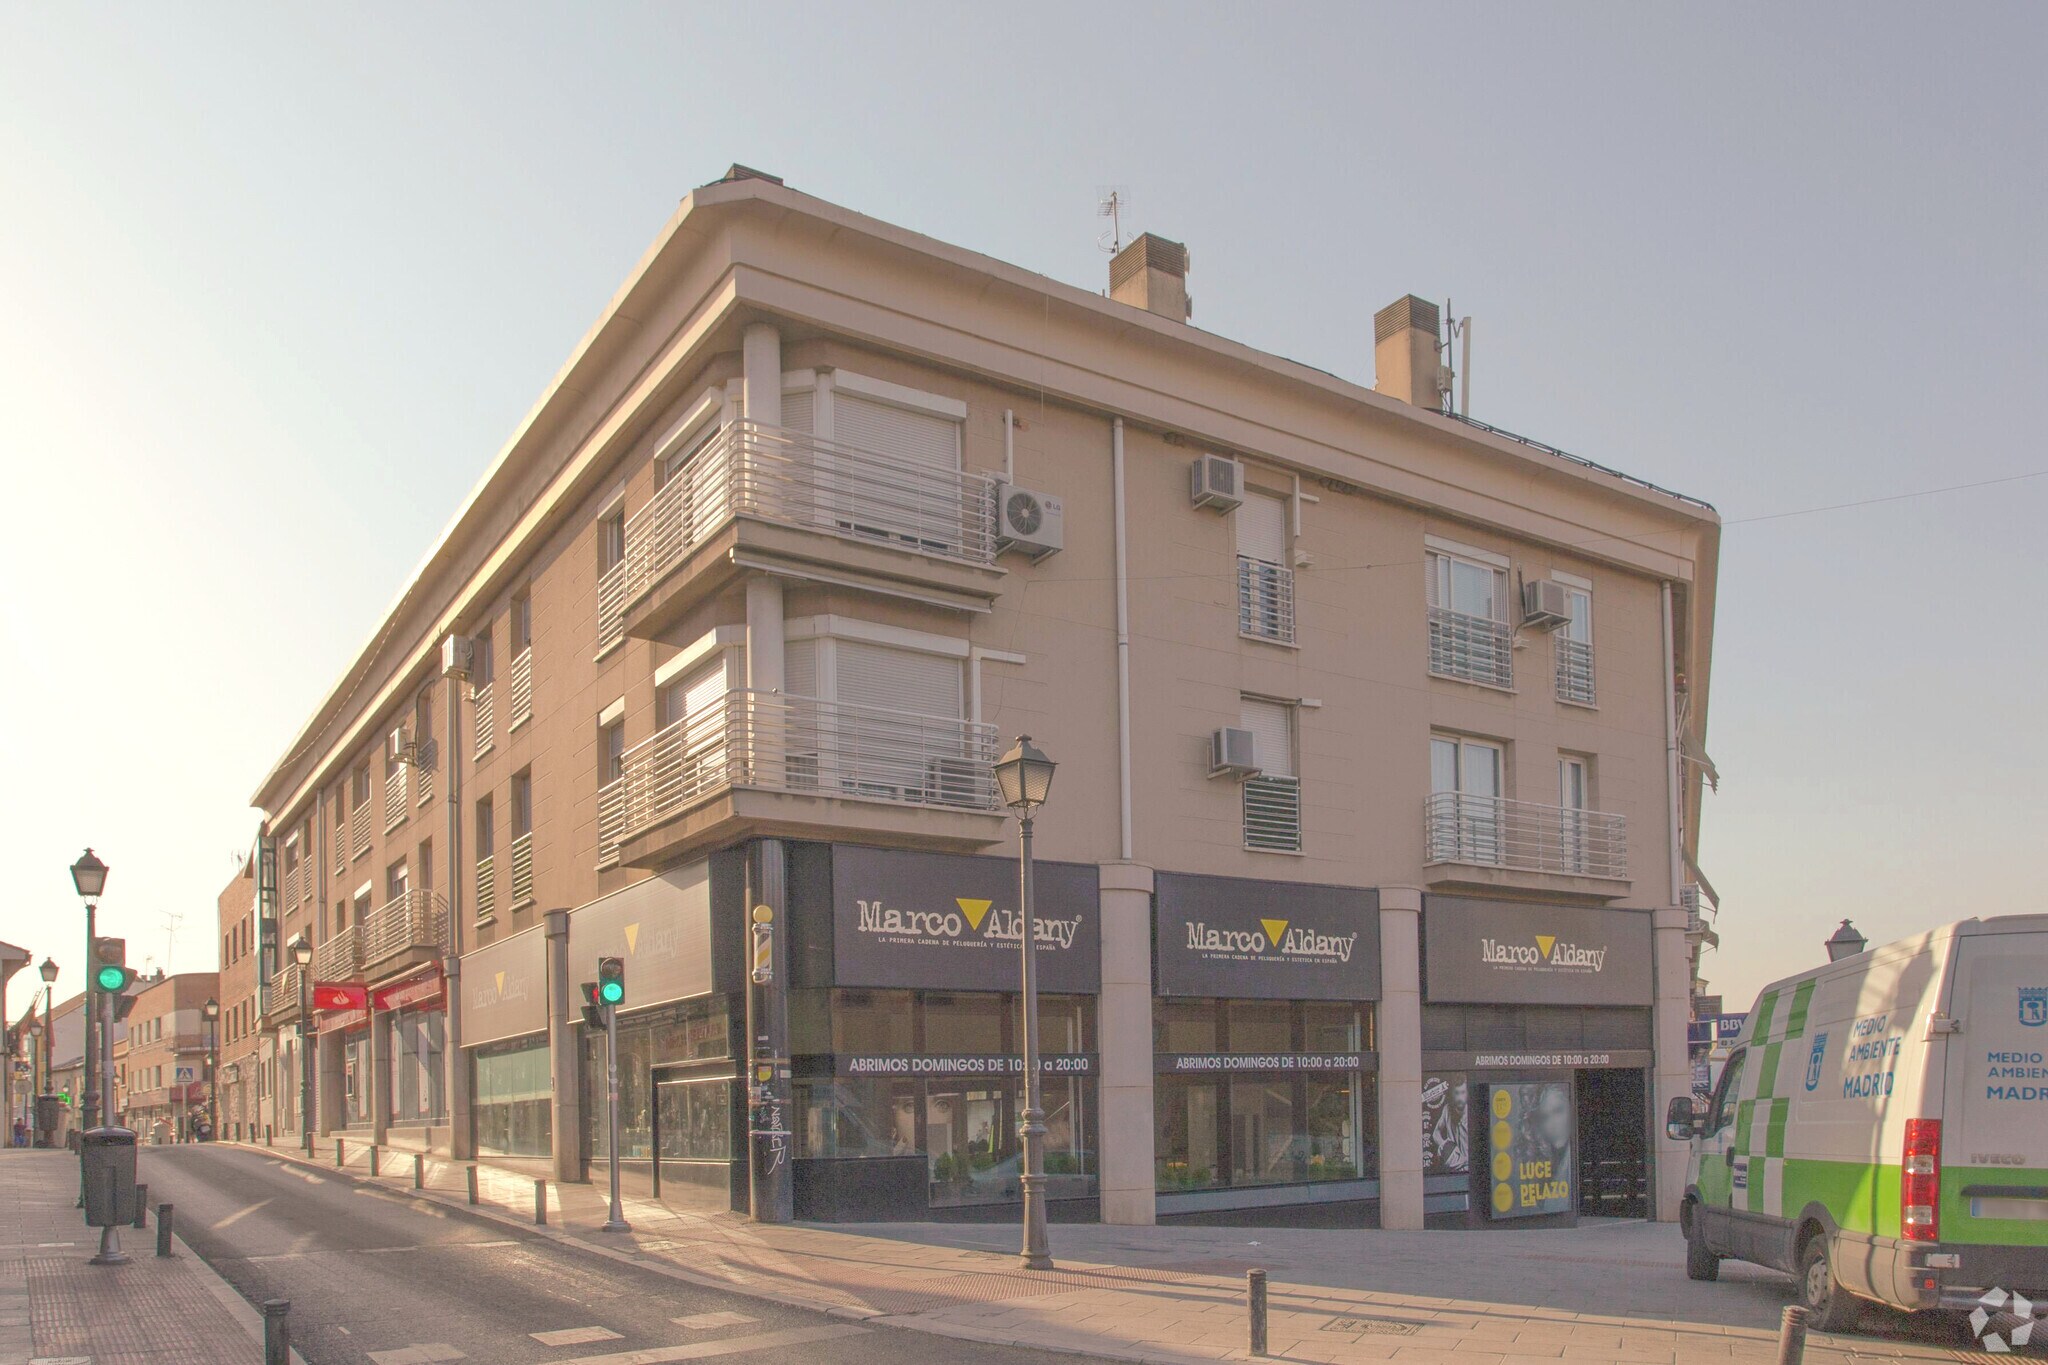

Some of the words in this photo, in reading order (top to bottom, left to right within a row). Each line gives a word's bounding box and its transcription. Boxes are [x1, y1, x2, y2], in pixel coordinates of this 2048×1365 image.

[857, 900, 961, 936] Marco
[997, 942, 1022, 950] ESTÉTIC
[1186, 922, 1265, 952] Marco
[1282, 928, 1354, 962] Aldany
[1482, 938, 1538, 964] Marco
[1551, 943, 1604, 972] Aldany
[1853, 1015, 1887, 1037] MEDIO
[1848, 1037, 1901, 1062] AMBIENTE
[1988, 1052, 2042, 1064] MEDIO
[850, 1058, 908, 1072] ABRIMOS
[912, 1058, 985, 1072] DOMINGOS
[988, 1058, 1004, 1071] DE
[1008, 1058, 1041, 1071] 10:
[1044, 1061, 1052, 1071] a
[1056, 1058, 1088, 1071] 20:00
[1176, 1057, 1221, 1069] ABRIMOS
[1224, 1057, 1279, 1068] DOMINGOS
[1282, 1057, 1294, 1068] DE
[1297, 1057, 1322, 1068] 10:00
[1324, 1059, 1331, 1067] a
[1334, 1056, 1359, 1067] 20:00
[1475, 1056, 1508, 1065] ABRIMOS
[1510, 1056, 1550, 1065] DOMINGOS
[1552, 1055, 1561, 1064] DE
[1563, 1055, 1581, 1064] 10:00
[1590, 1055, 1609, 1064] 20:00
[1843, 1072, 1894, 1098] MADRID
[1971, 1153, 2025, 1165] IVECO
[1520, 1161, 1552, 1180] LUCE
